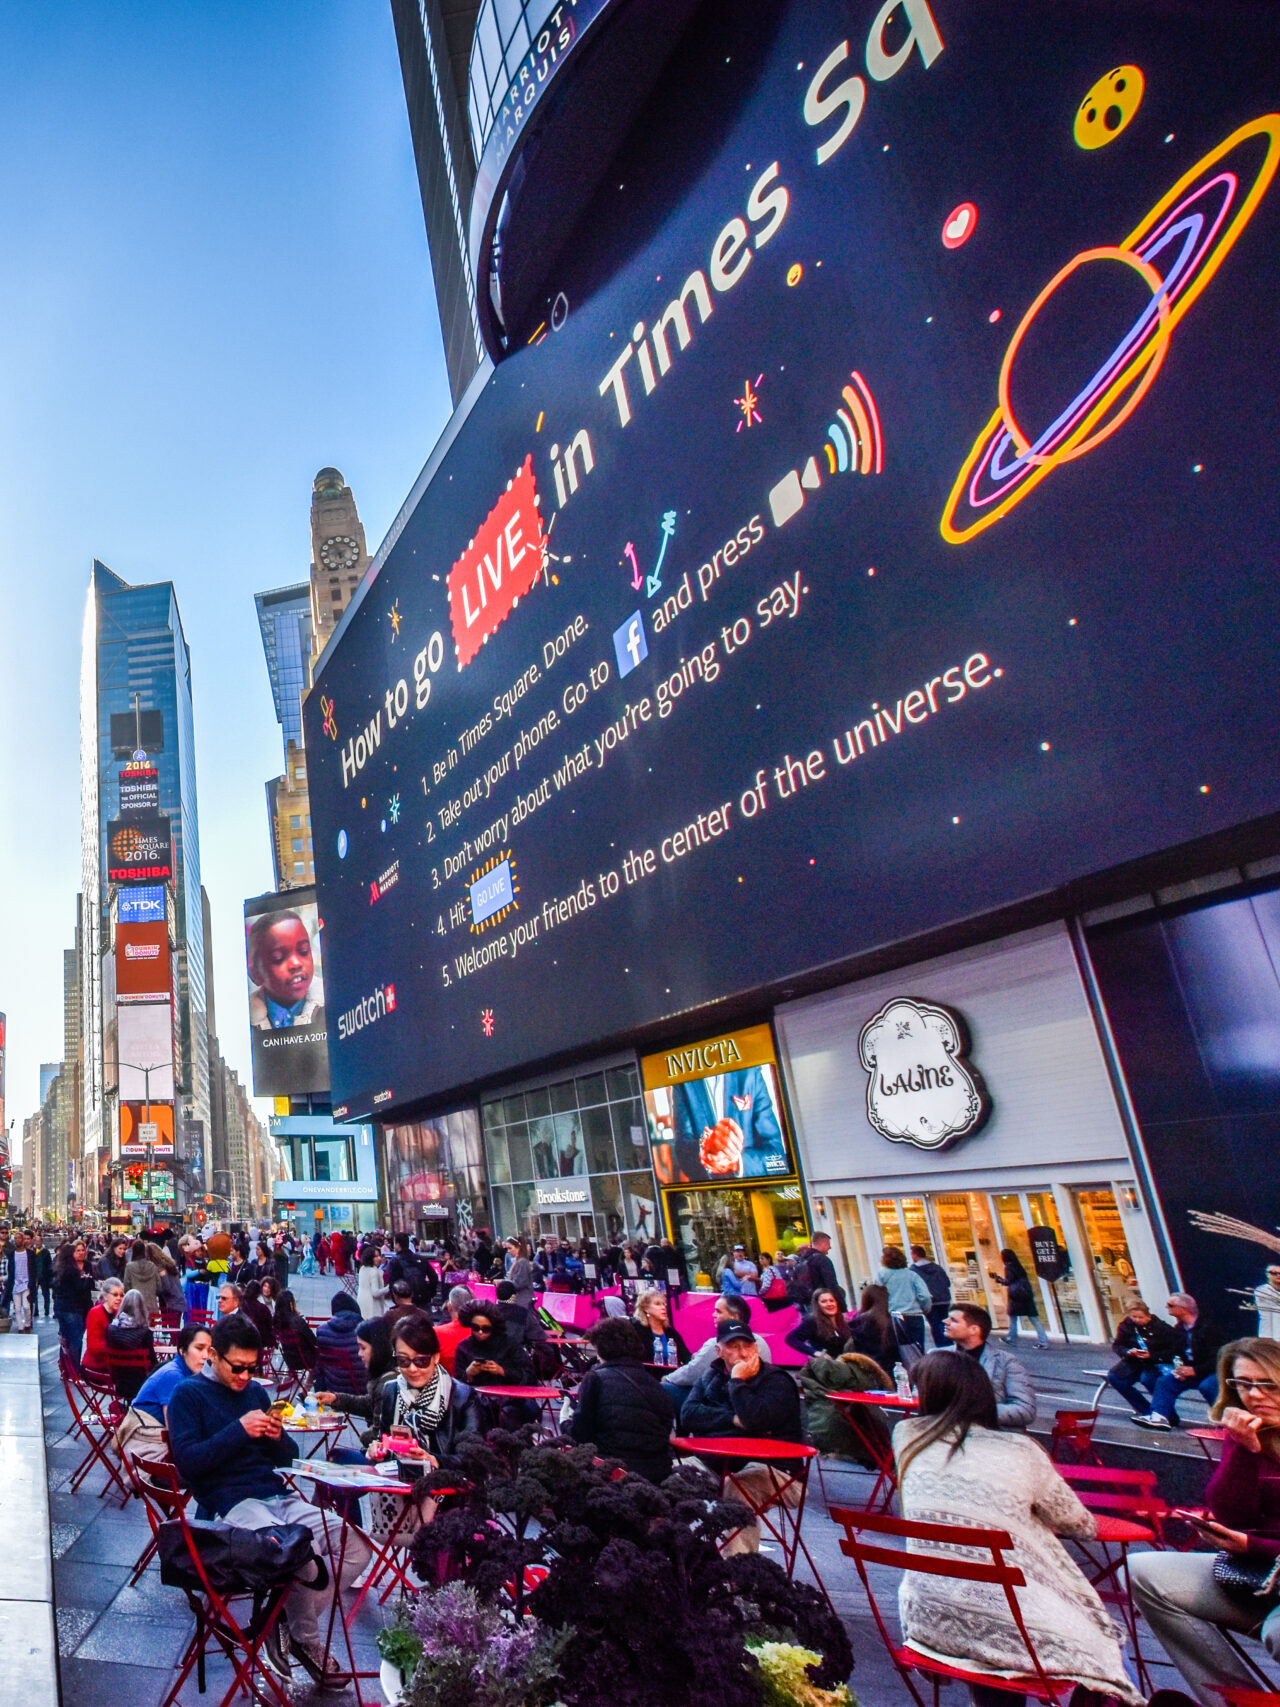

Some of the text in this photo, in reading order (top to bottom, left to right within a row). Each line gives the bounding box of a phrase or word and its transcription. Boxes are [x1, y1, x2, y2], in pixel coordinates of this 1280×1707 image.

[341, 710, 381, 788] How
[385, 679, 409, 728] to
[414, 631, 444, 709] go
[462, 510, 526, 628] LIVE
[550, 429, 595, 509] in
[599, 161, 789, 428] Times
[426, 821, 436, 843] 2.
[438, 799, 462, 831] Take
[463, 777, 483, 809] out
[483, 751, 511, 798] your
[513, 707, 561, 770] phone.
[563, 681, 588, 715] Go
[589, 660, 610, 693] to
[653, 573, 693, 633] and
[698, 514, 765, 602] press
[422, 613, 590, 796] 1. Be in Times Square. Done.
[432, 571, 810, 890] 3. Don't worry about what you're going to say.
[120, 768, 158, 778] TOSHIBA
[125, 761, 151, 770] 2016
[120, 783, 157, 793] TOSHIBA
[121, 801, 151, 809] SPONSOR
[129, 793, 157, 801] OFFICIAL
[442, 652, 1005, 988] 5. Welcome your friends to the center of the universe.
[133, 836, 158, 845] TIMES
[138, 842, 170, 851] SQUARE
[109, 866, 171, 880] TOSHIBA
[130, 900, 161, 910] TDK
[437, 878, 506, 936] 4. Hit GO LIVE
[337, 986, 386, 1041] swatch
[262, 1038, 280, 1048] CAN
[284, 1034, 304, 1045] HAVE
[304, 1034, 311, 1043] A
[310, 1032, 328, 1042] 2017
[664, 1038, 741, 1079] INVICTA
[536, 1187, 587, 1205] Brookstone
